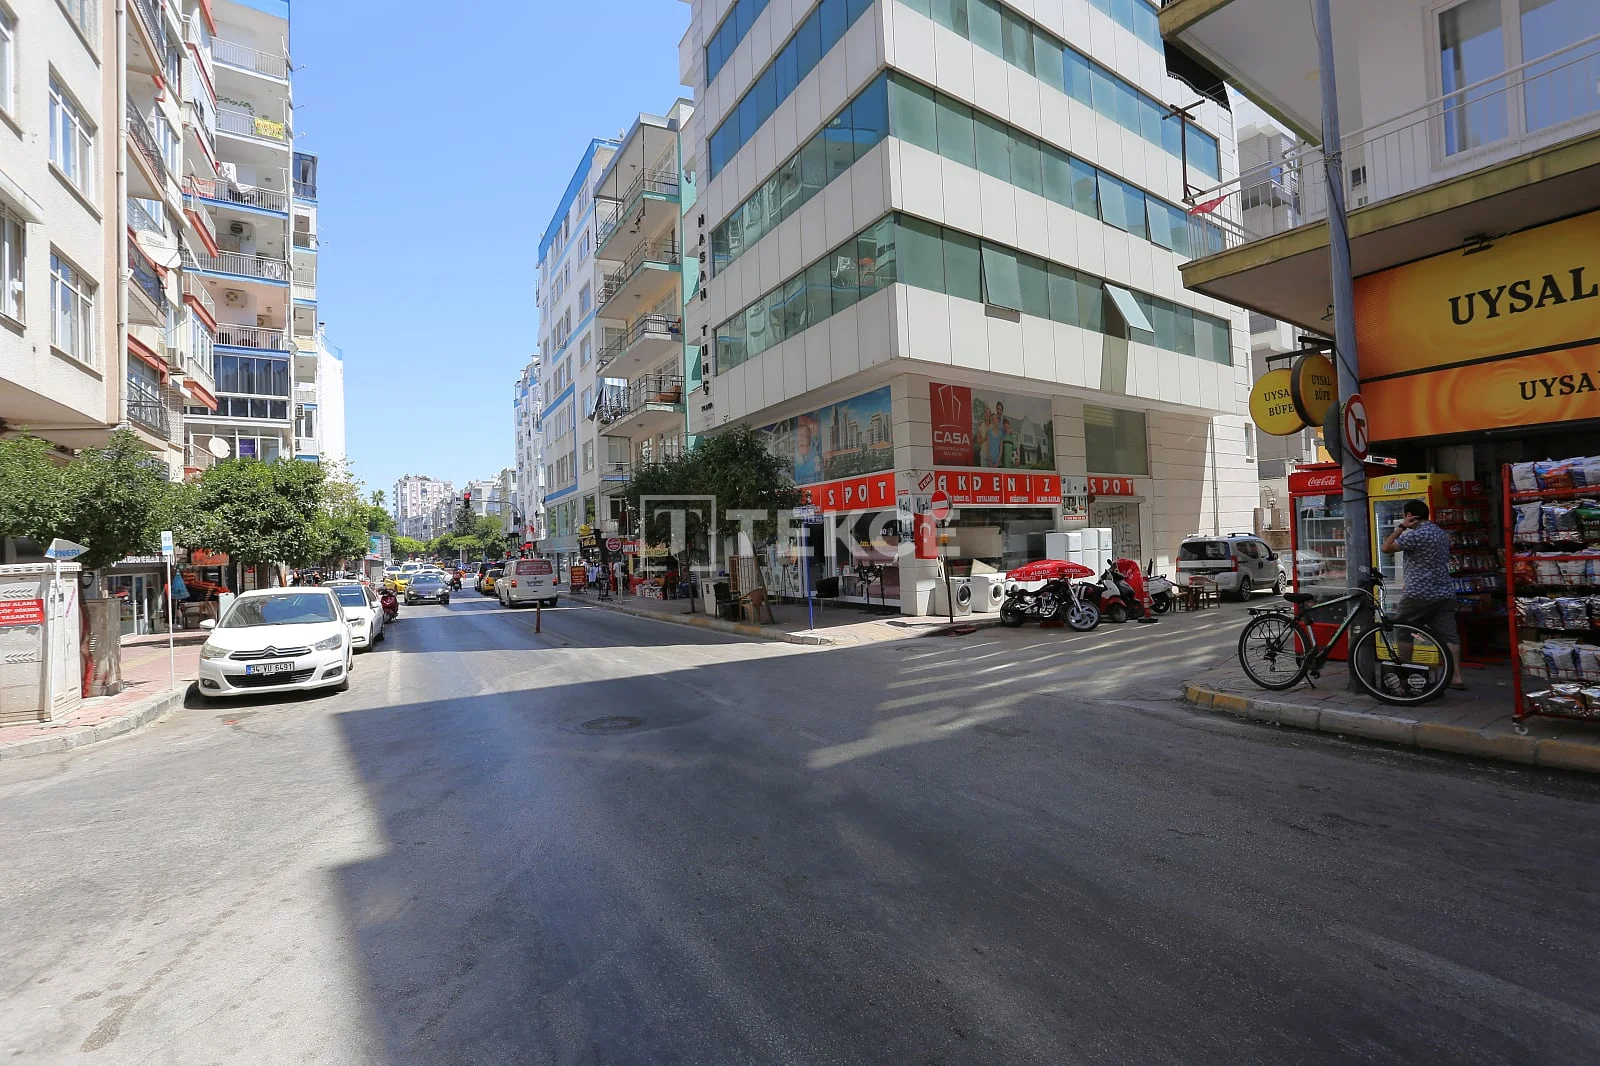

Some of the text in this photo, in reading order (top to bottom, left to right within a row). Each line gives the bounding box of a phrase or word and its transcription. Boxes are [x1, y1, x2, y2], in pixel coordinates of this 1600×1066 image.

[1448, 266, 1599, 326] UYSAL
[1311, 374, 1332, 386] UYSAL
[1518, 370, 1600, 401] UYSA
[1264, 388, 1291, 402] UYSA
[1315, 389, 1331, 401] BÜFE
[1268, 403, 1295, 417] BÜFE
[933, 430, 970, 445] CASA
[829, 481, 887, 506] SPOT
[1090, 479, 1133, 494] SPOT
[275, 663, 293, 672] 6491
